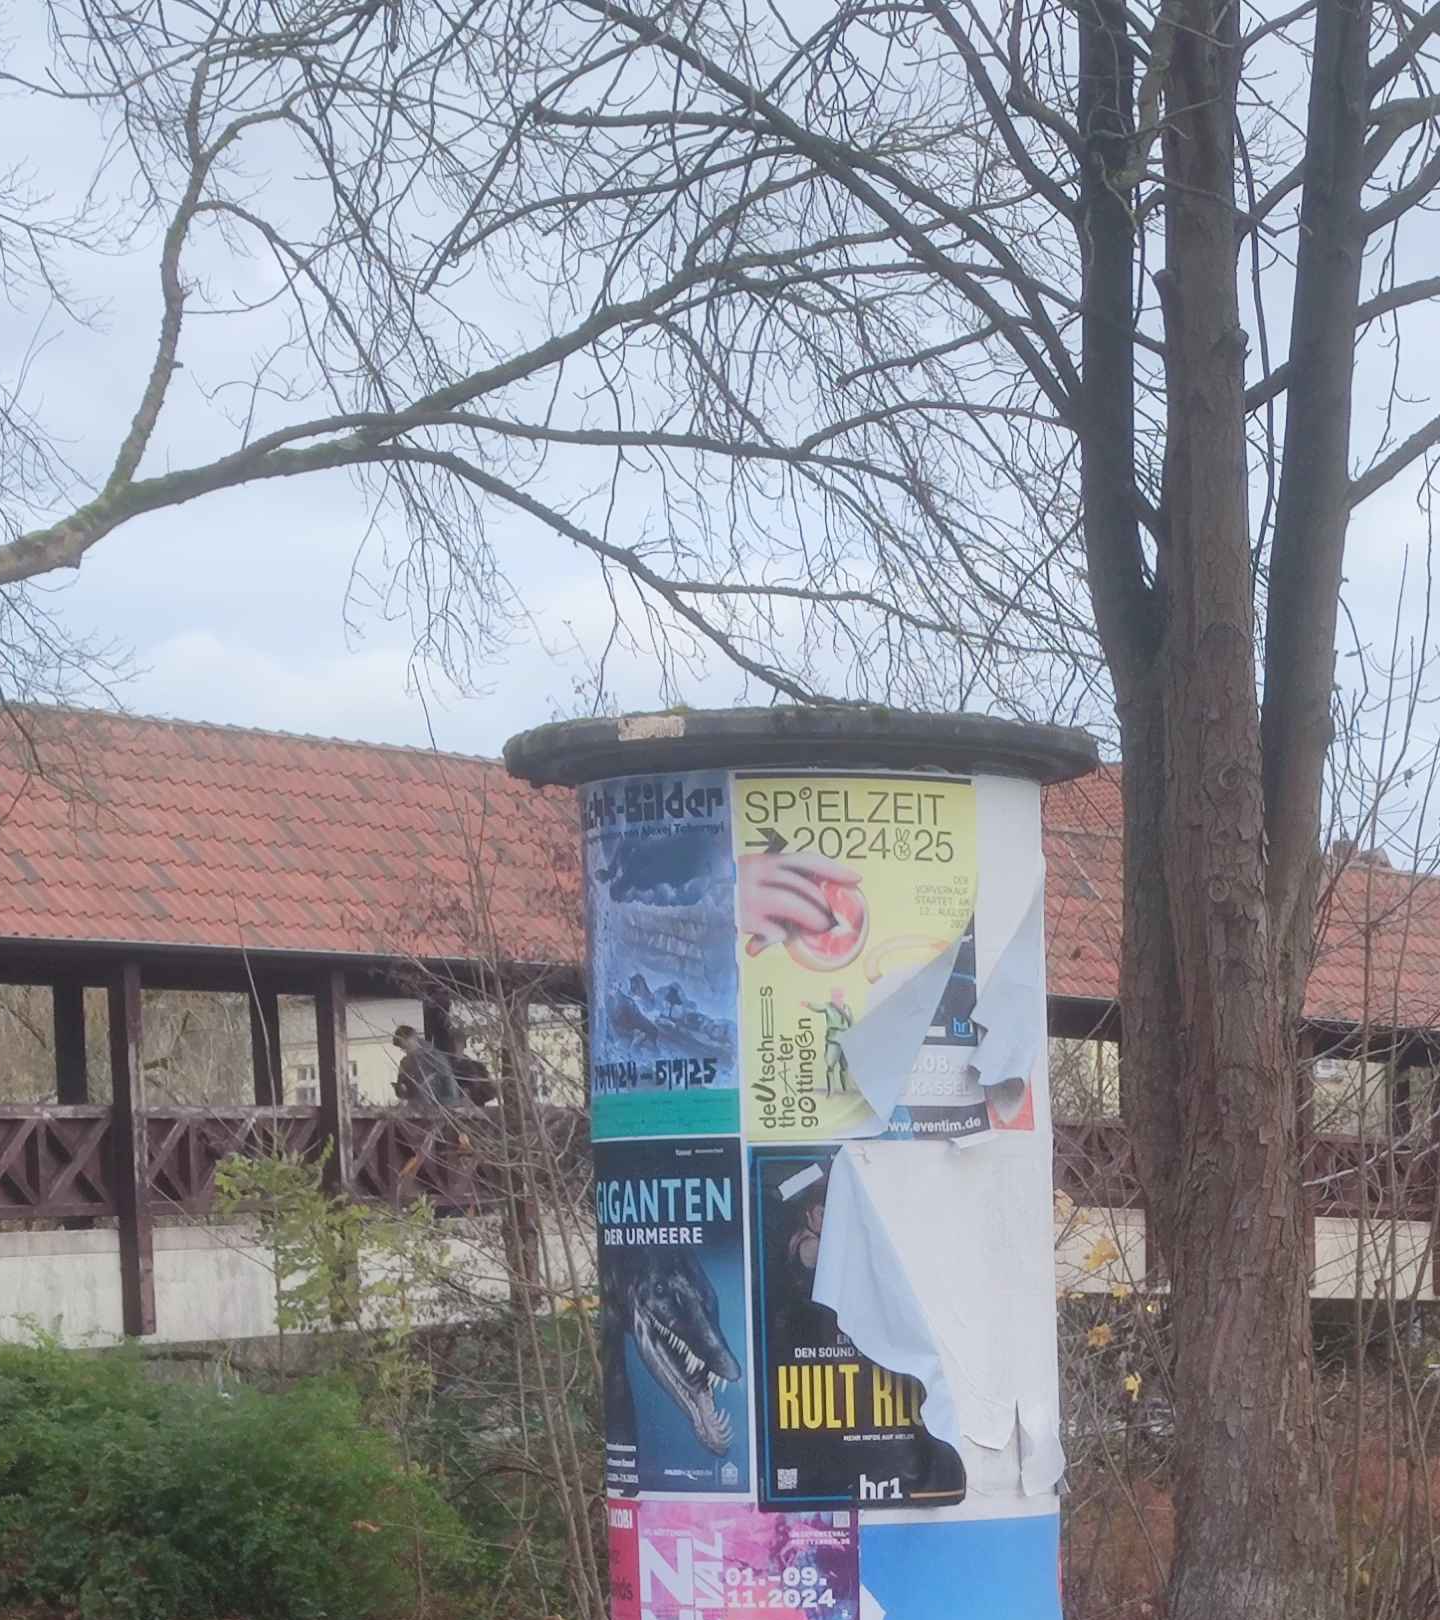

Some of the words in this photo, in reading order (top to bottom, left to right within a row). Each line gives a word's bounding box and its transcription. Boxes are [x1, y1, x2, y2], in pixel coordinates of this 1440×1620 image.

[596, 1177, 732, 1225] GIGANTEN
[604, 1228, 624, 1246] DER
[626, 1226, 703, 1245] URMEERE
[795, 1348, 816, 1359] DEN
[819, 1347, 855, 1358] SOUND
[778, 1363, 860, 1430] KULT
[859, 1473, 904, 1500] hr1
[727, 1587, 836, 1608] 11.2024
